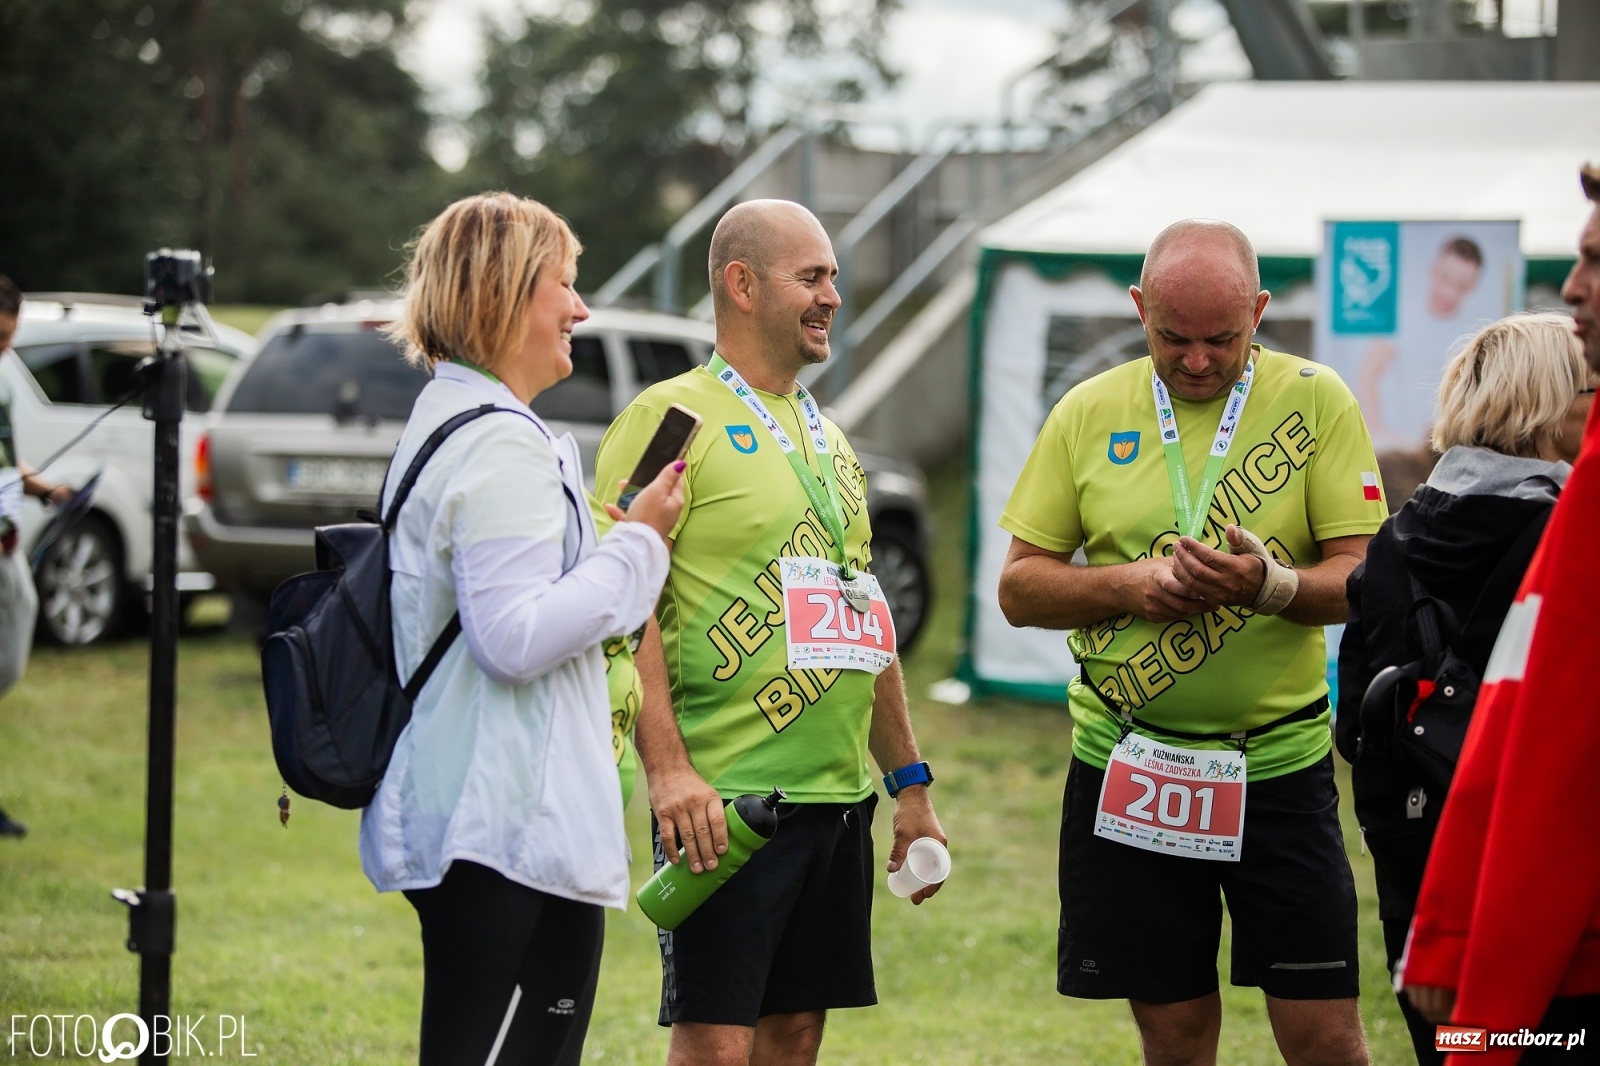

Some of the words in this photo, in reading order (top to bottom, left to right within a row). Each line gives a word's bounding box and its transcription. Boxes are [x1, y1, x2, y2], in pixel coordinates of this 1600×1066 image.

[807, 593, 883, 646] 204
[1153, 748, 1195, 765] KUŹNIAŃSKA
[1144, 758, 1164, 772] LEŚNA
[1165, 764, 1201, 778] ZADYSZKA
[1125, 772, 1215, 831] 201
[661, 886, 677, 901] aok.de
